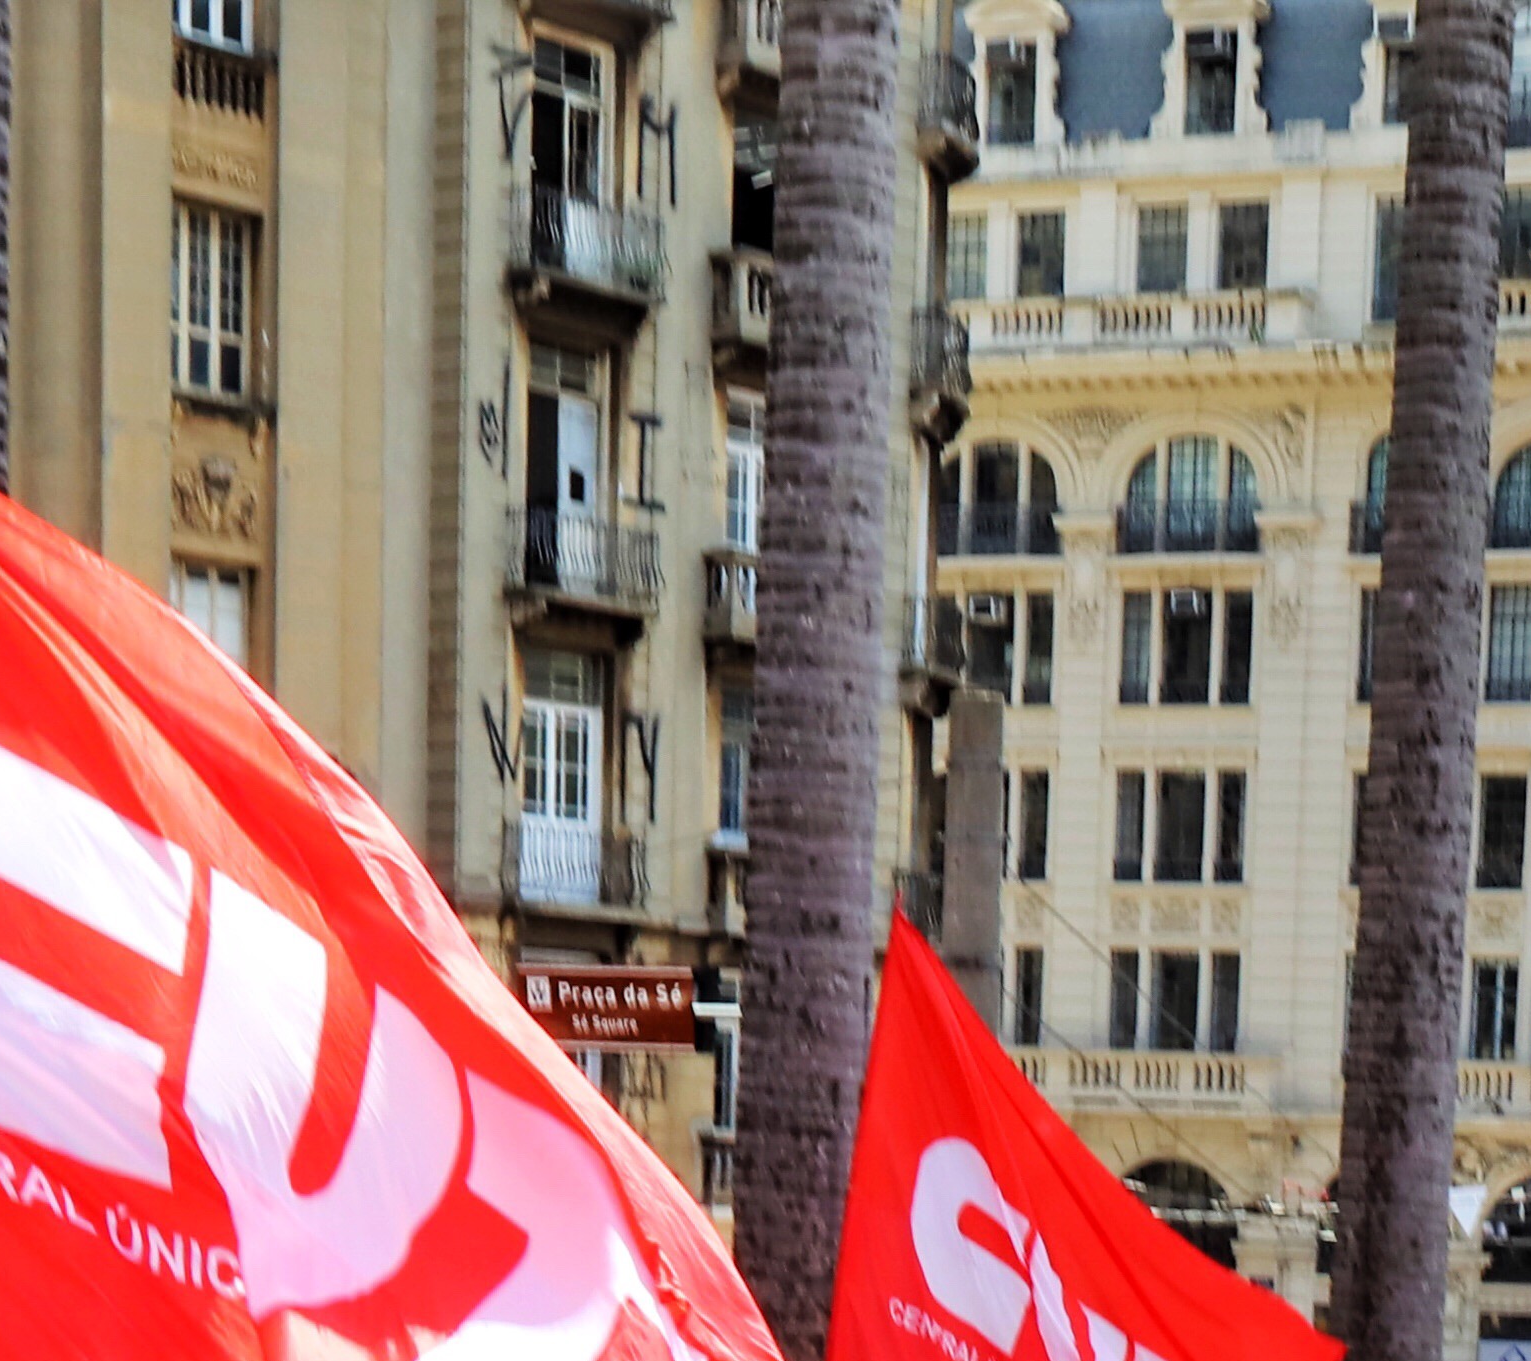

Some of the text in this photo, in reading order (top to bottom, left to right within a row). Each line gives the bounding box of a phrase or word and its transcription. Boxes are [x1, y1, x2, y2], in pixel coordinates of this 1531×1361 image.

[558, 980, 684, 1011] Praça da Sé
